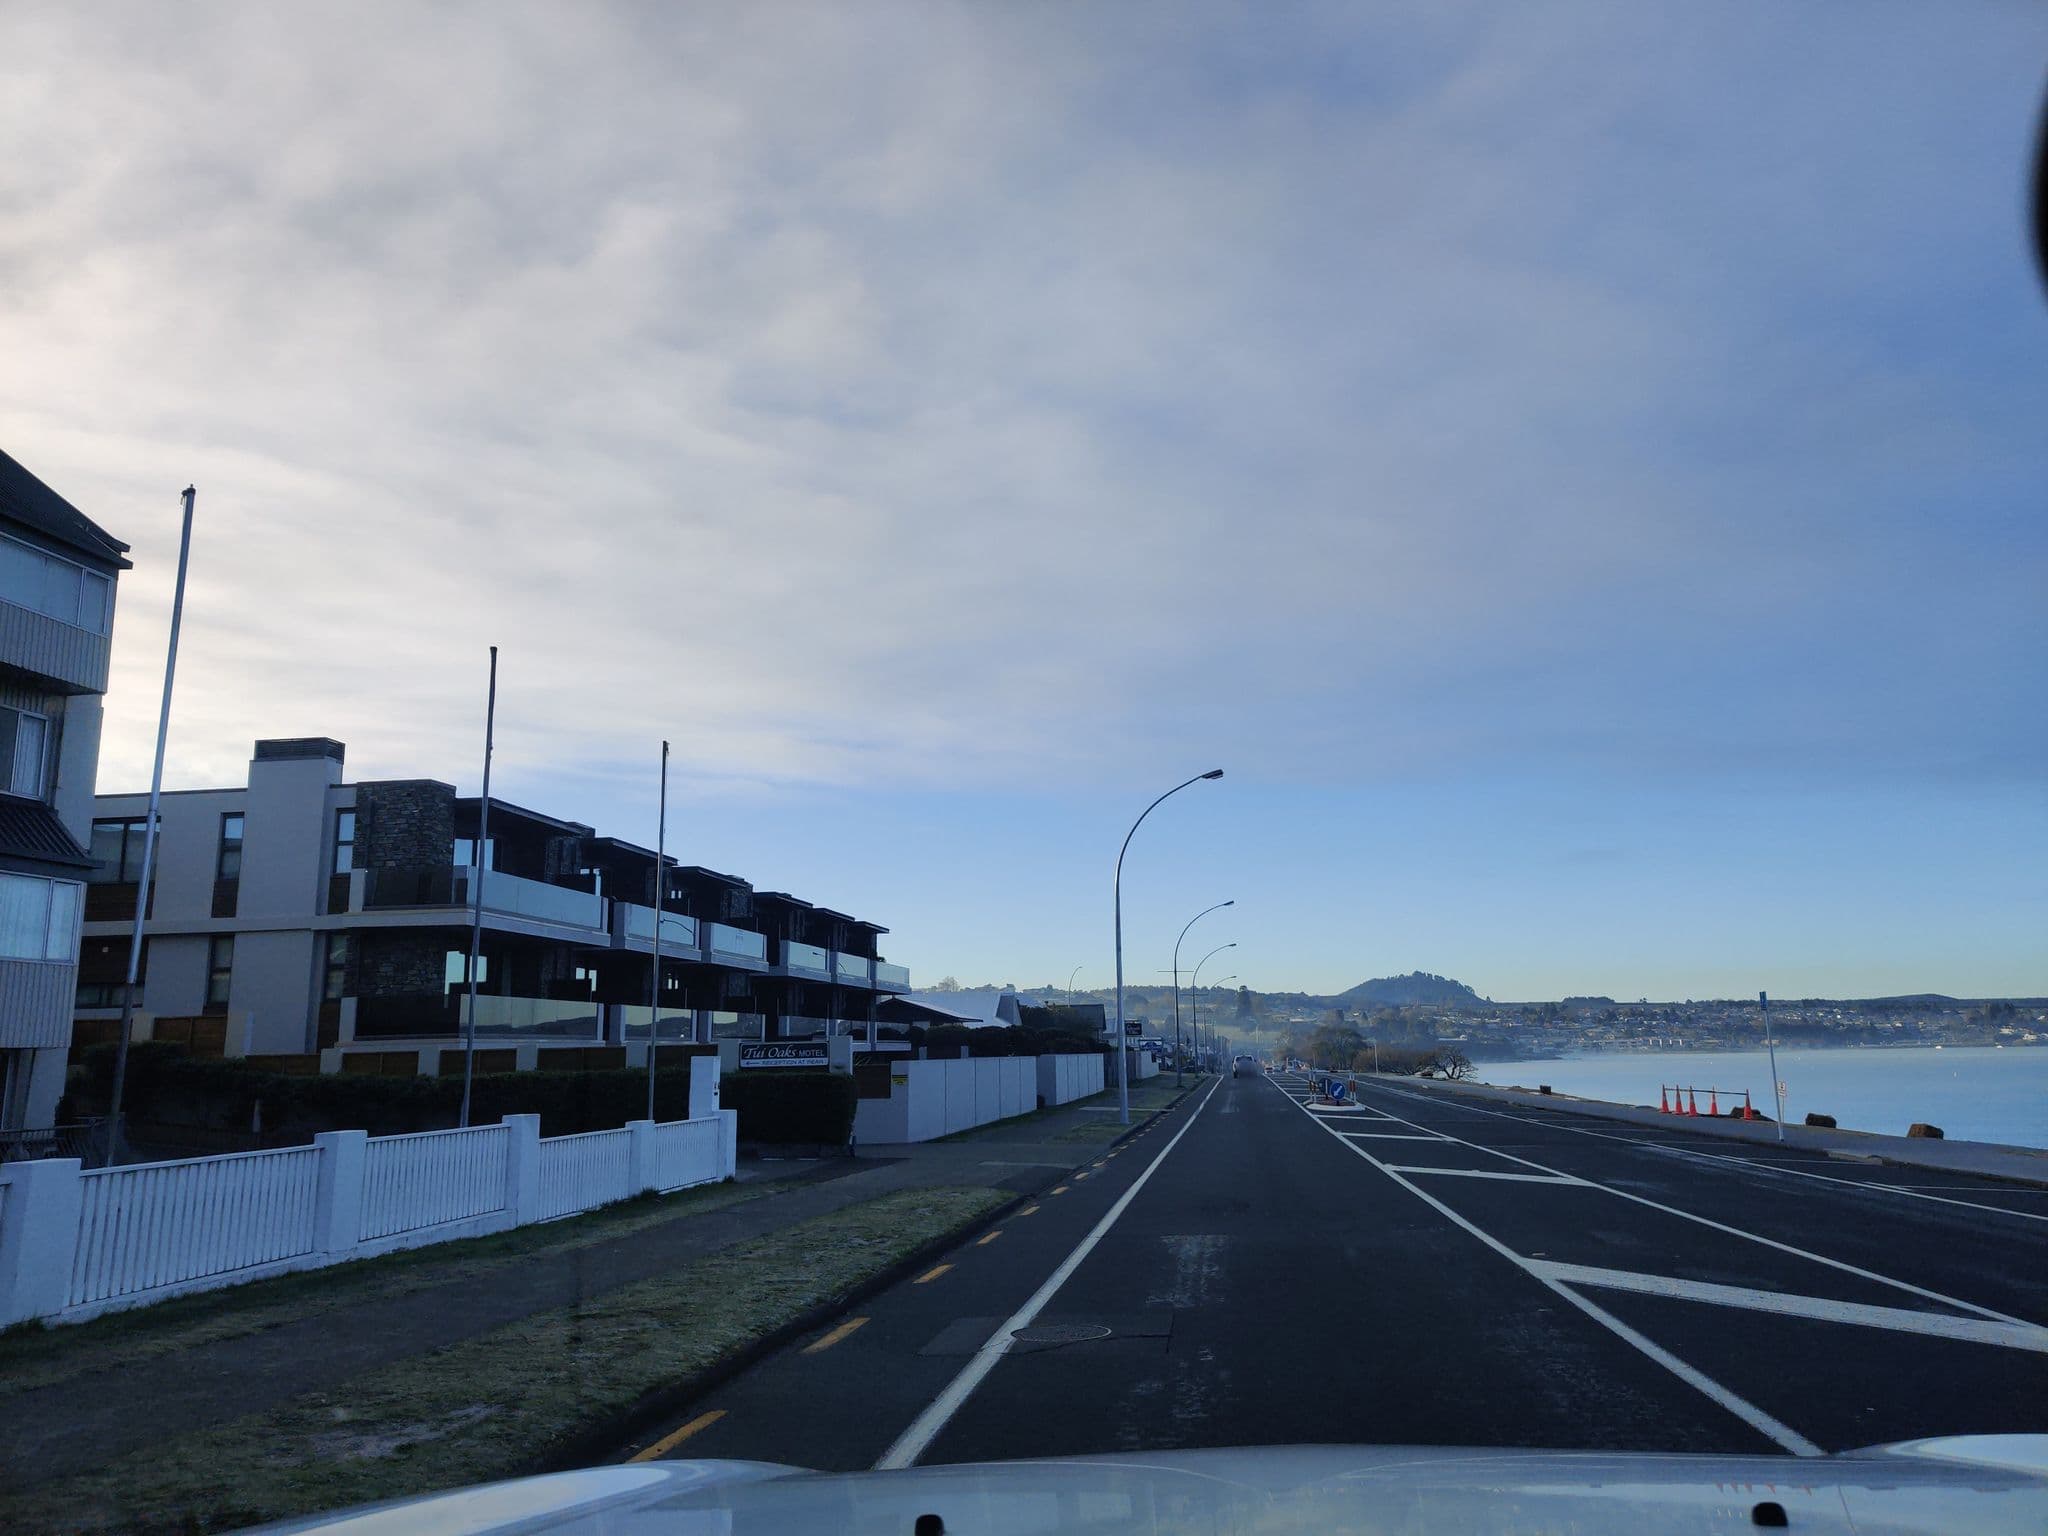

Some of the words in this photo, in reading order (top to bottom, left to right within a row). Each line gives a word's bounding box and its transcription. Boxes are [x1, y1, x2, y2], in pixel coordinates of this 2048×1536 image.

[743, 1045, 765, 1058] Tui
[767, 1045, 796, 1058] Oaks
[798, 1049, 824, 1057] MOTEL
